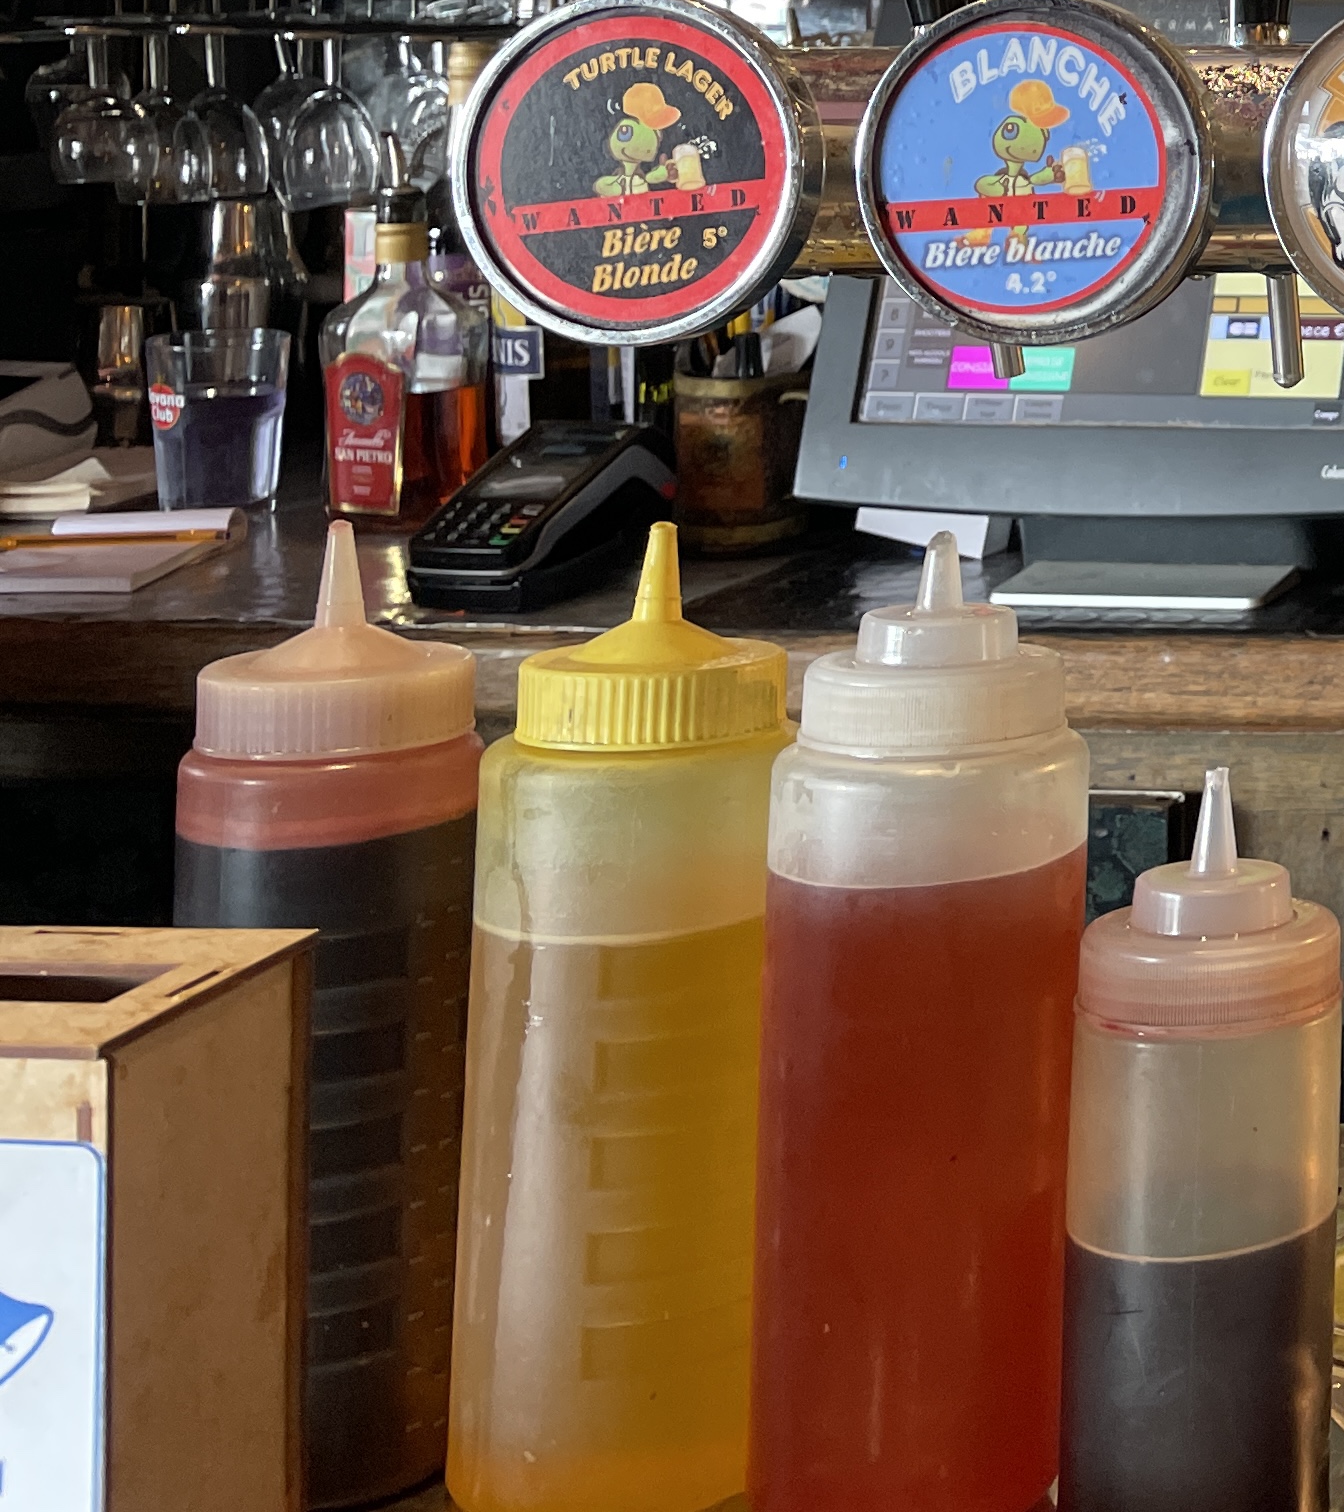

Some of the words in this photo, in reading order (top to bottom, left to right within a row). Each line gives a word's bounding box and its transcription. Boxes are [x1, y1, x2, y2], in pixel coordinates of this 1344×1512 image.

[563, 46, 661, 92] TURTLE
[664, 52, 735, 121] LAGER
[950, 36, 1126, 136] BLANCHE
[523, 188, 747, 231] WANTED
[896, 195, 1137, 230] WANTED
[602, 224, 682, 258] Bière
[702, 226, 728, 250] 5°
[925, 238, 1000, 269] Bière
[1005, 231, 1122, 264] blanche
[592, 254, 699, 294] Blonde
